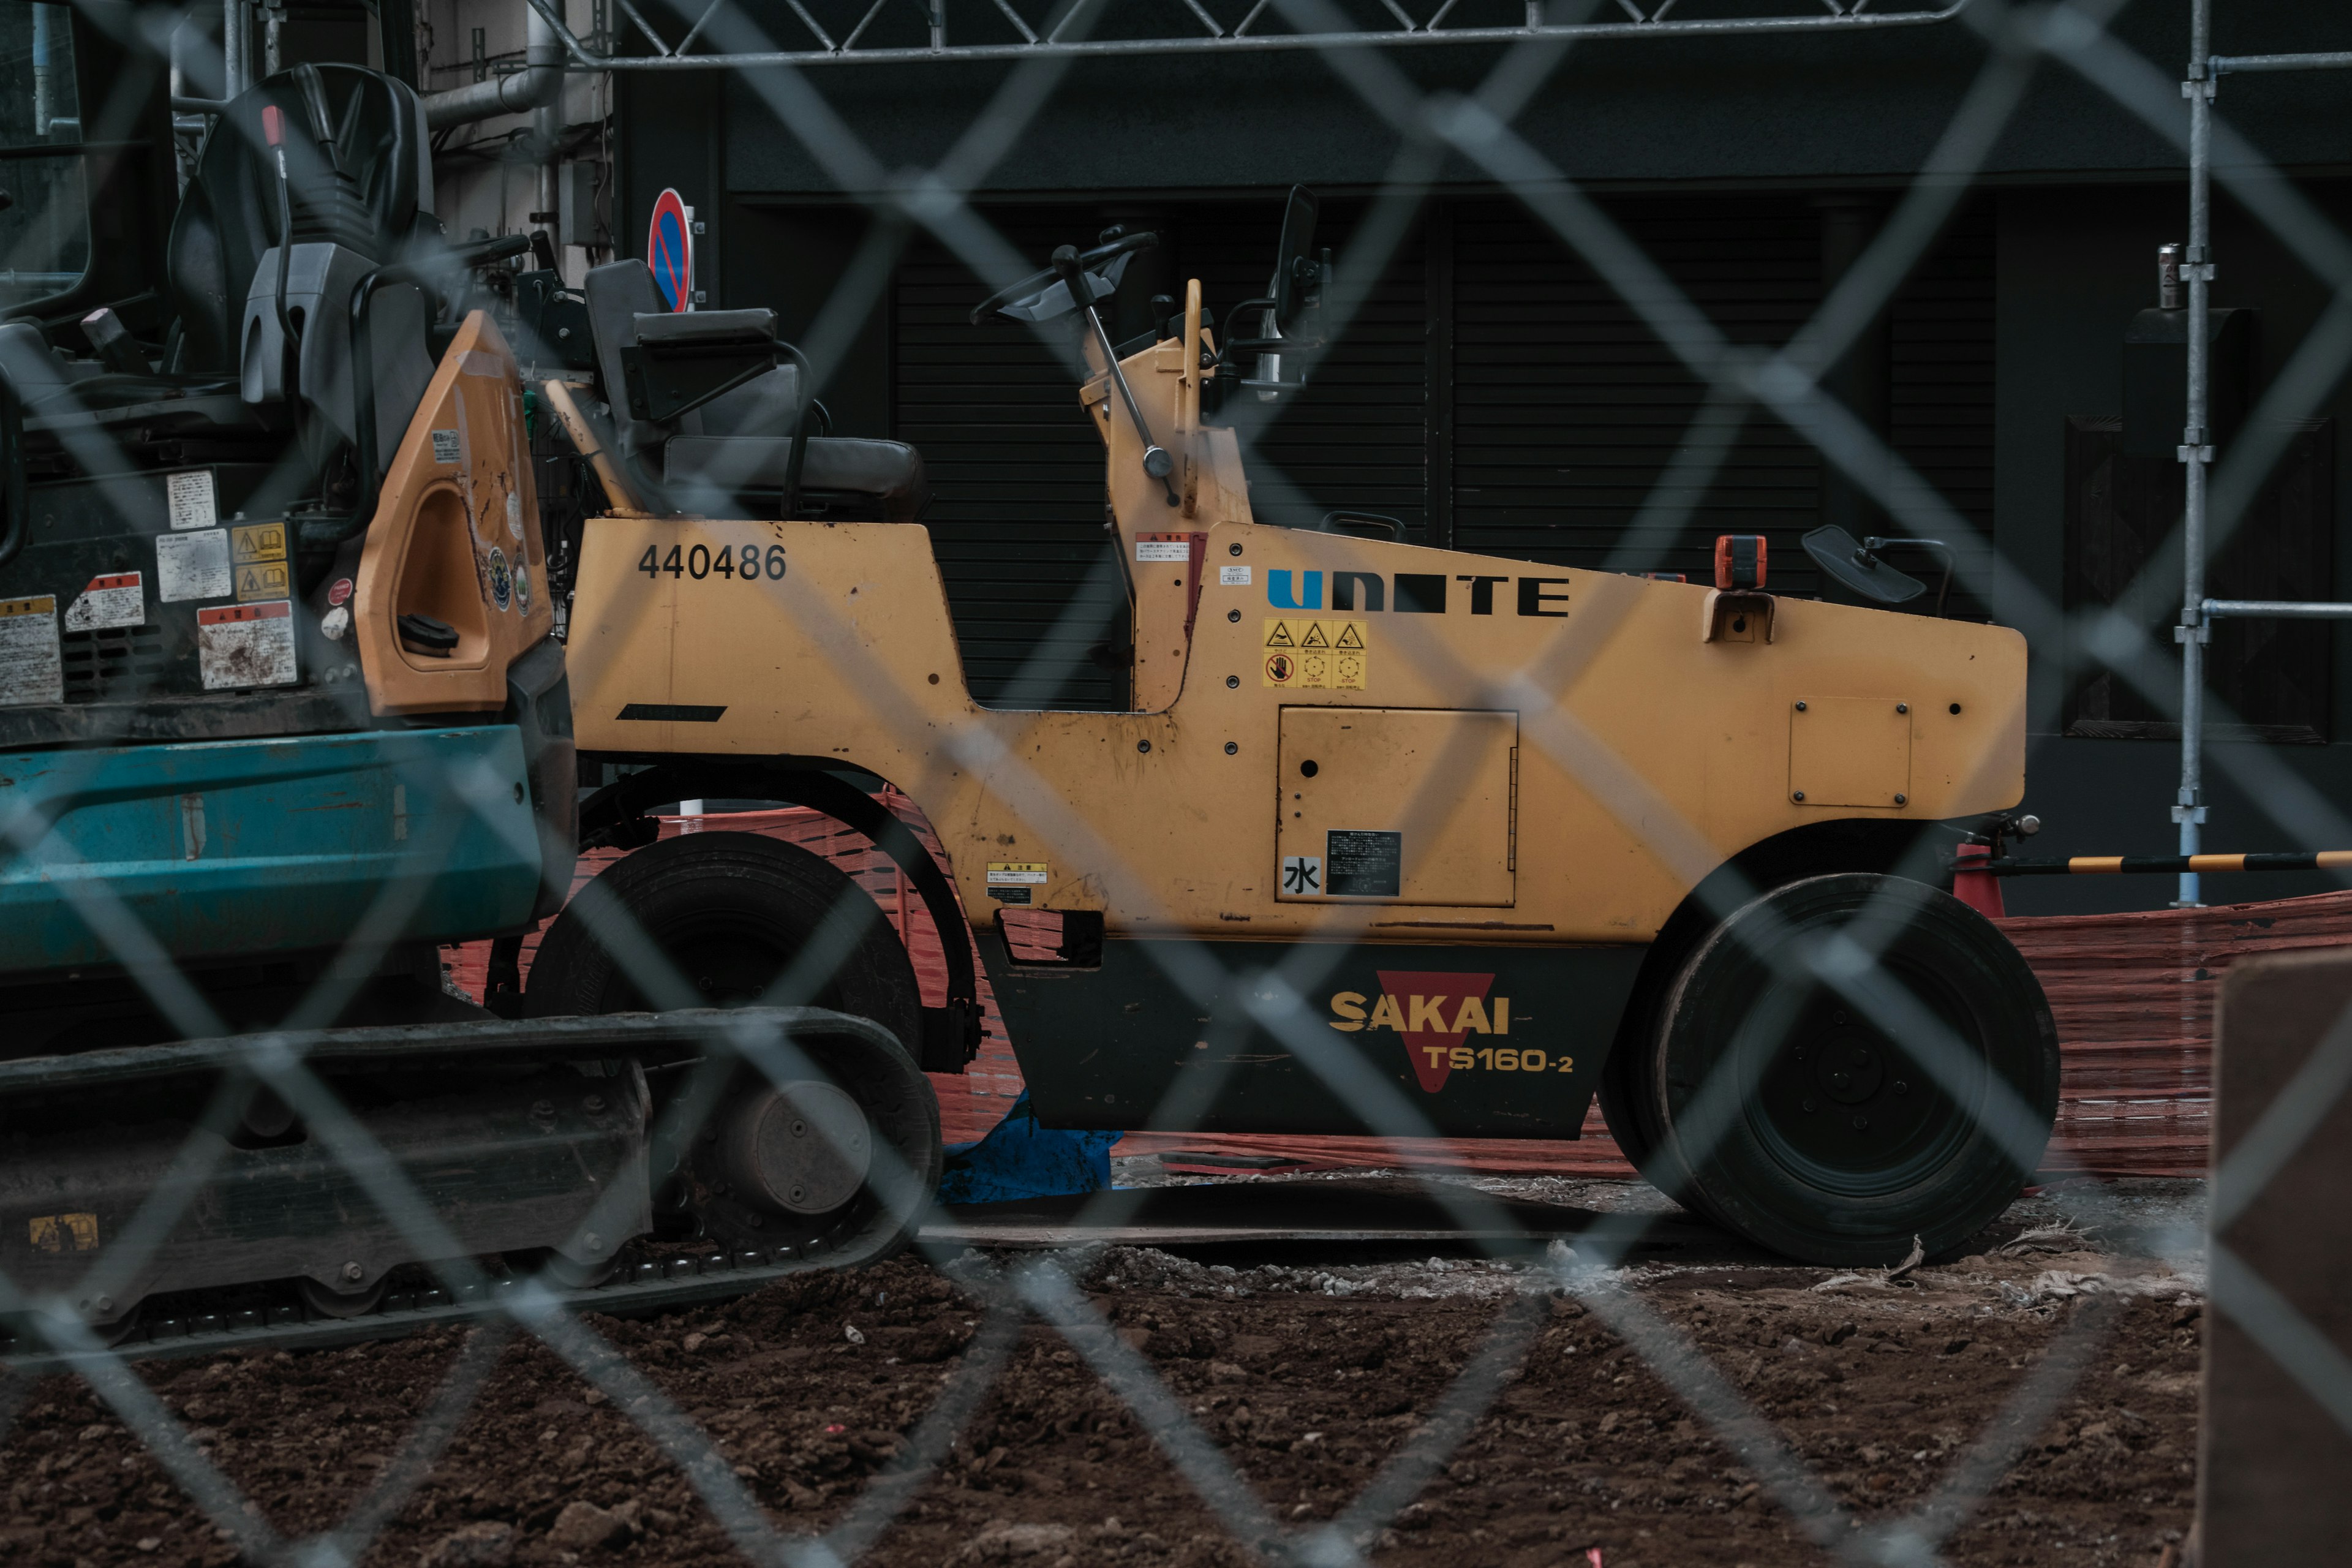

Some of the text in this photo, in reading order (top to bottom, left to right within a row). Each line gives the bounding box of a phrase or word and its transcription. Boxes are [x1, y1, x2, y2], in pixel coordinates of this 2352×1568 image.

[638, 544, 786, 581] 440486
[1284, 858, 1319, 894] 水
[1329, 991, 1509, 1035] SAKAI
[1423, 1046, 1574, 1073] TS160-2
